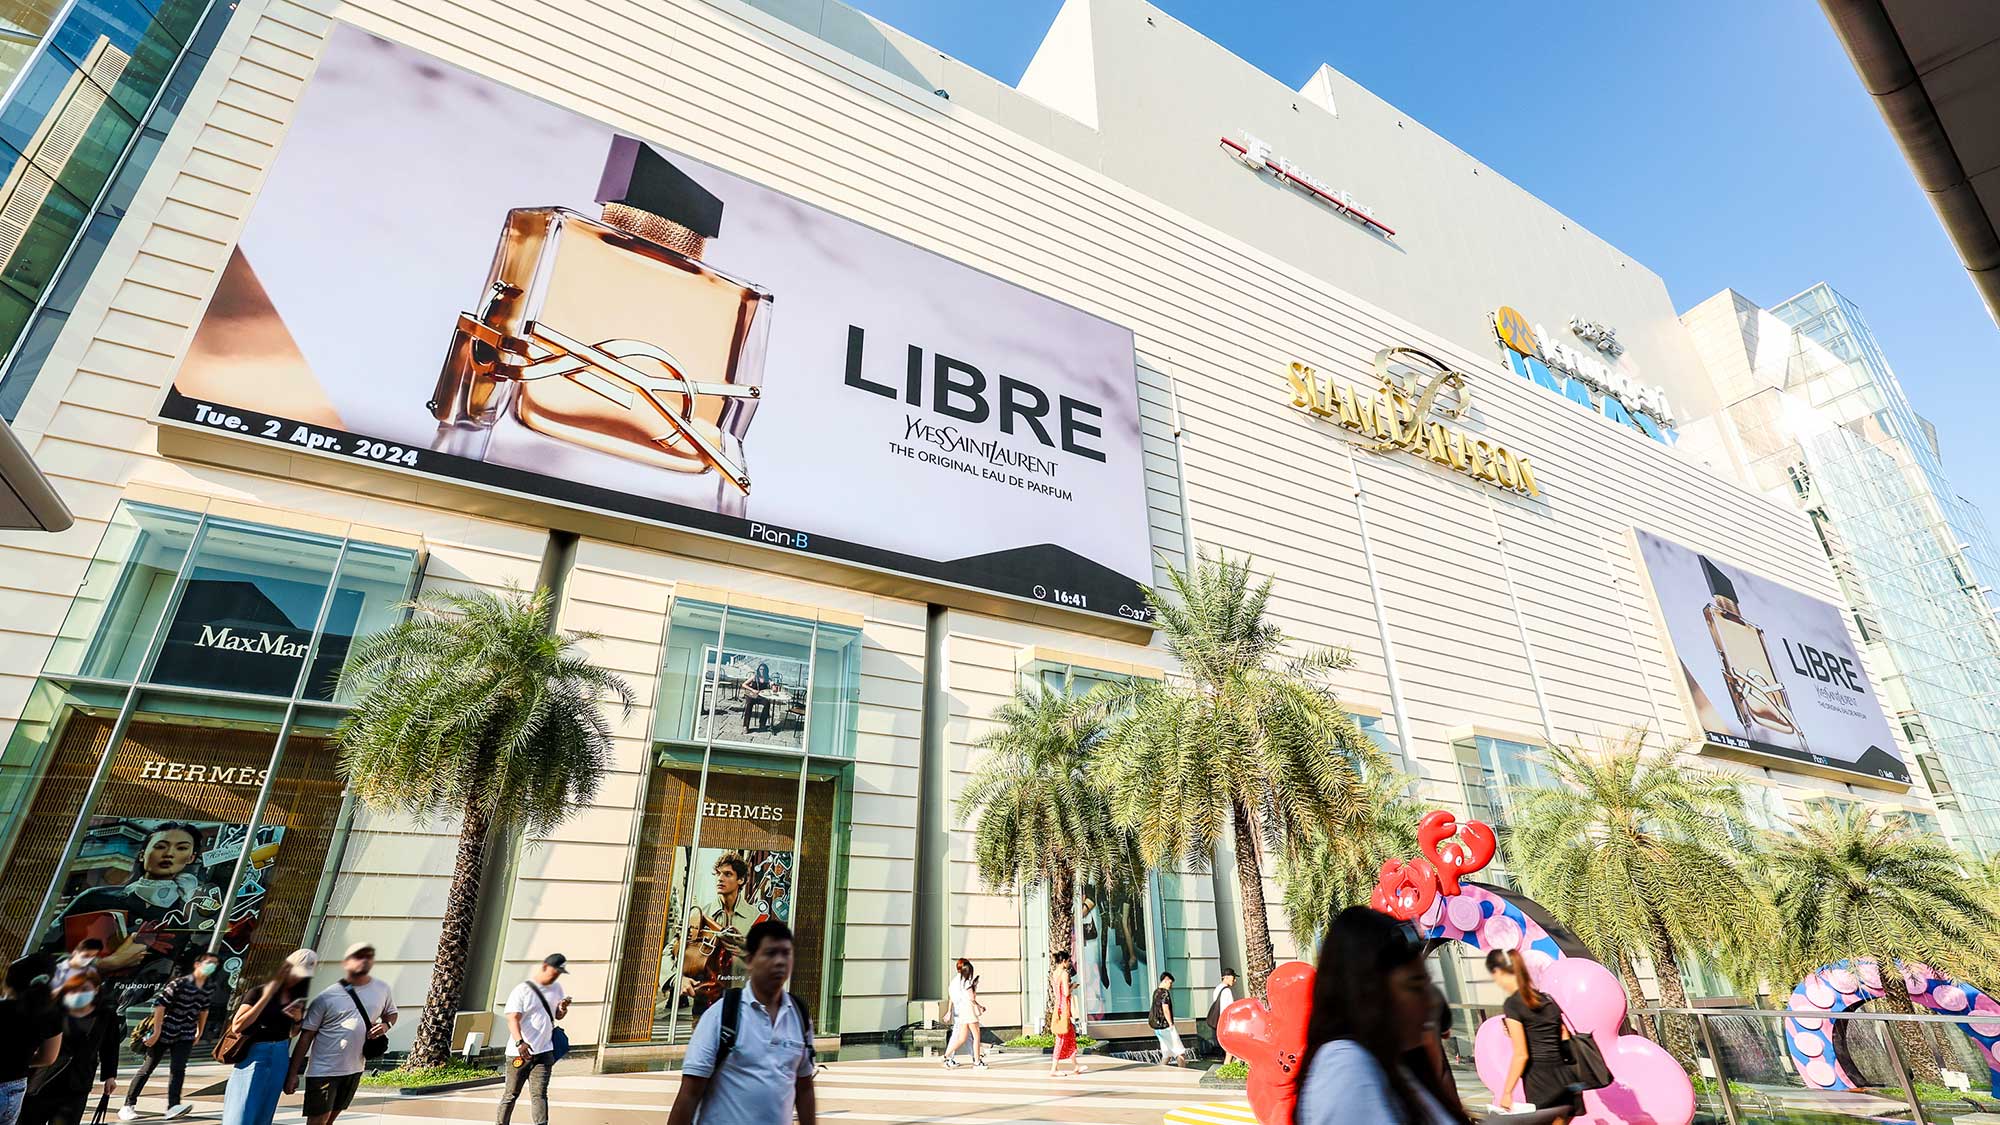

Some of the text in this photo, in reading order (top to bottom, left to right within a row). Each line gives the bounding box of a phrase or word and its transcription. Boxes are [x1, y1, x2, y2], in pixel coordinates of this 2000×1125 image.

[845, 324, 1107, 464] LIBRE
[194, 404, 418, 467] Tue. 2 Apr. 2024
[889, 442, 1073, 502] THE ORIGINAL EAU DE PARFUM
[1054, 589, 1087, 608] 16:41
[194, 624, 320, 660] MaxMar
[1782, 638, 1865, 694] LIBRE
[702, 802, 783, 821] HERMÈS
[113, 981, 161, 991] Faubourg
